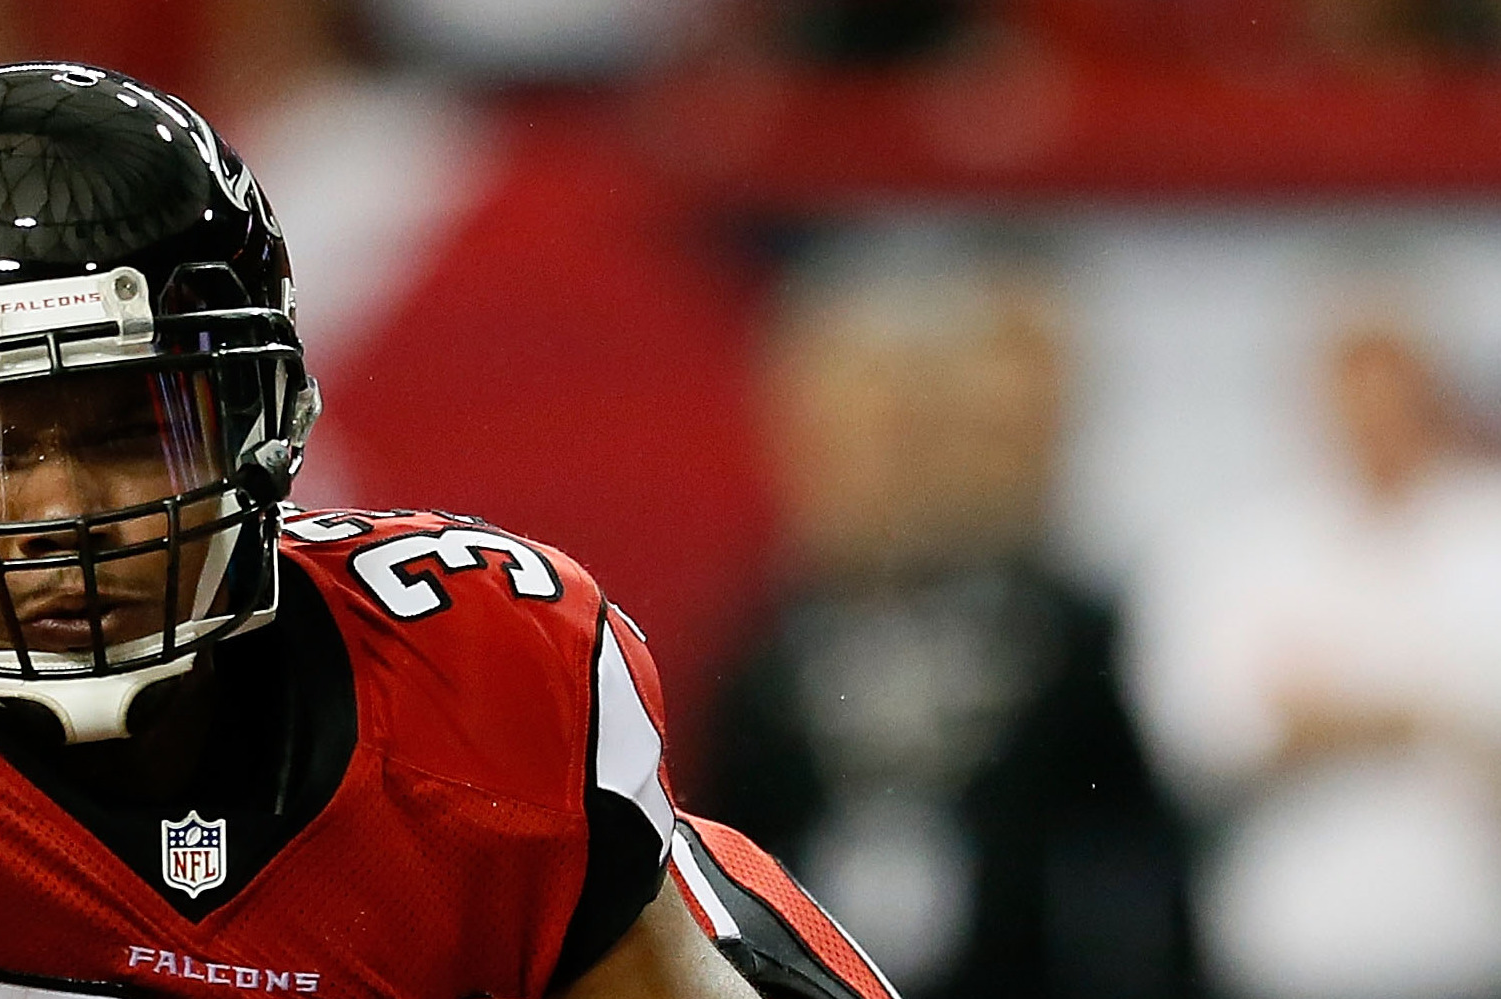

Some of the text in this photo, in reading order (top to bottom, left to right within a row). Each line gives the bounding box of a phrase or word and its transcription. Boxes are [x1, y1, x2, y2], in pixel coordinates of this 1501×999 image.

[0, 292, 102, 314] FALCONS
[172, 850, 217, 883] NFL
[128, 945, 321, 992] FALCONS
